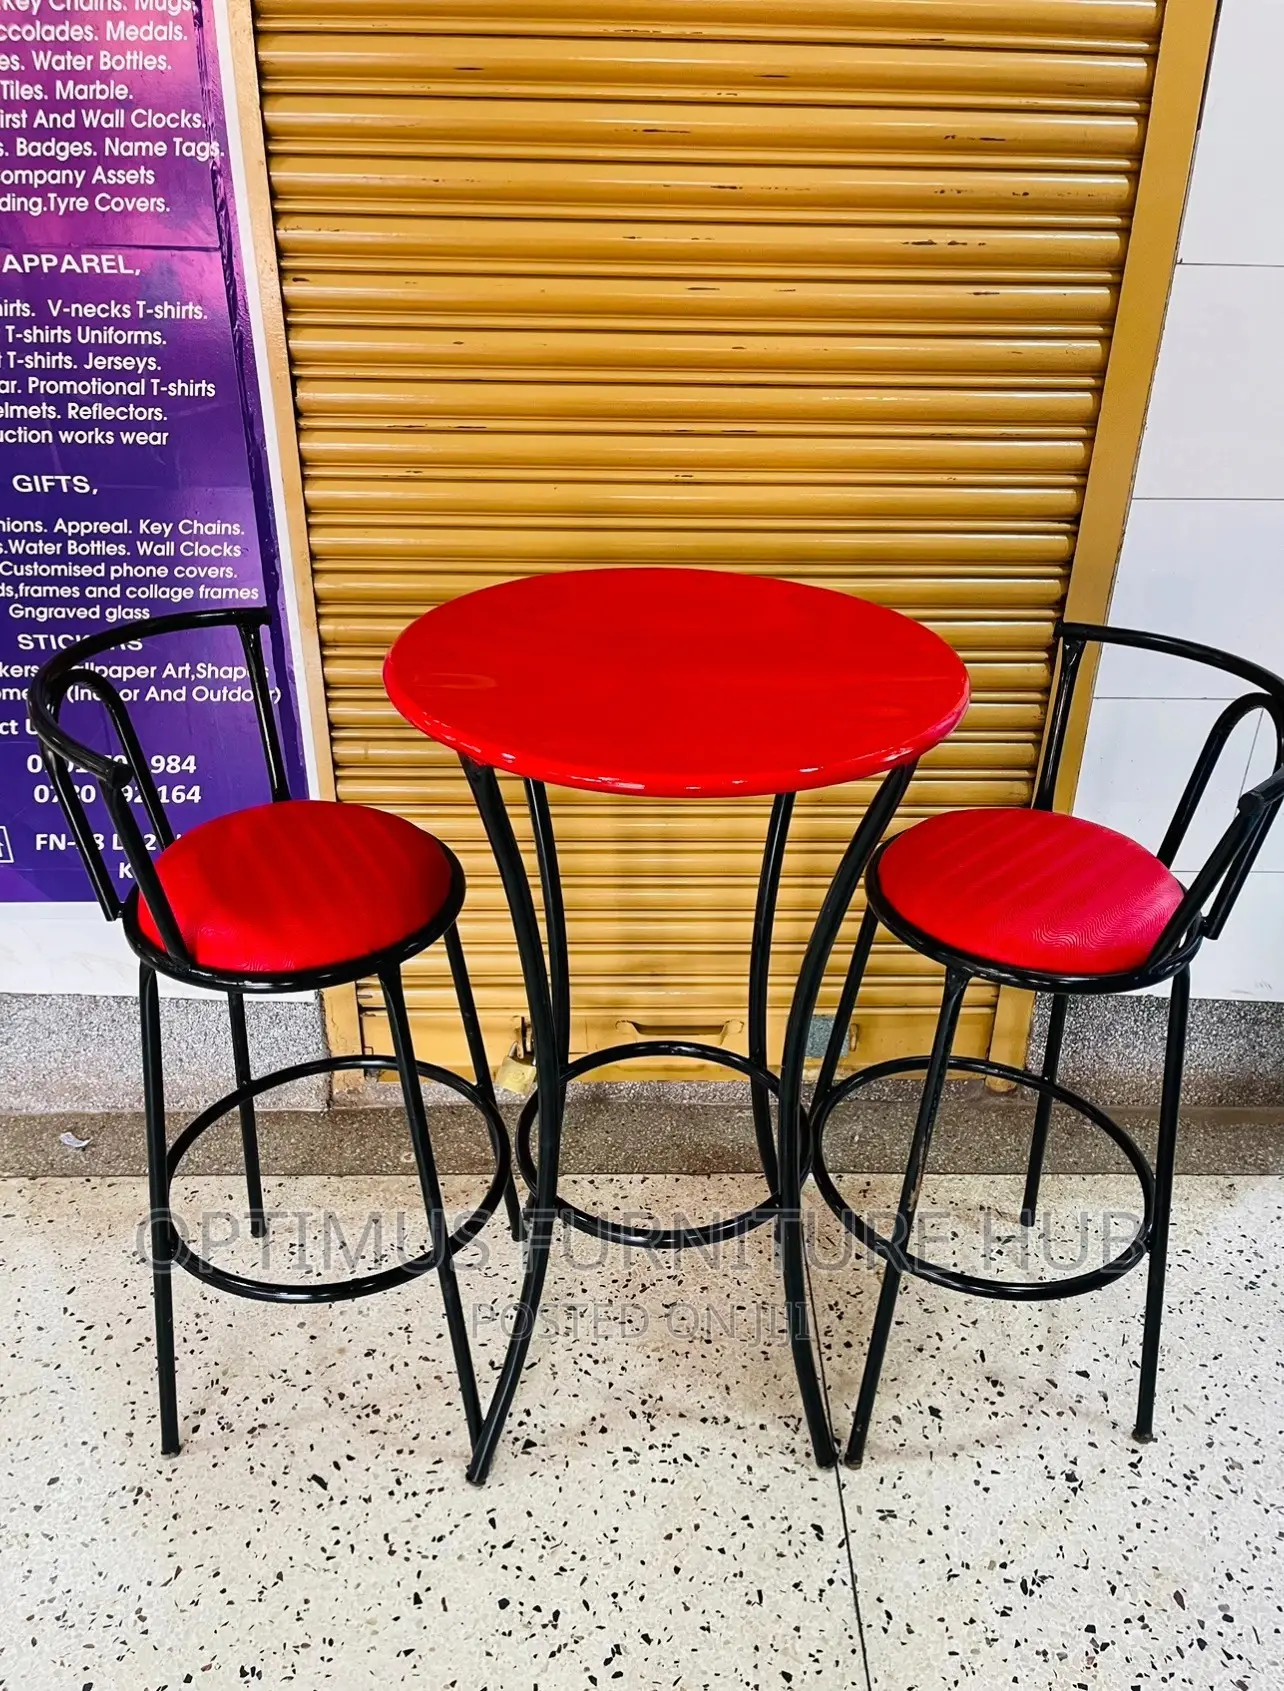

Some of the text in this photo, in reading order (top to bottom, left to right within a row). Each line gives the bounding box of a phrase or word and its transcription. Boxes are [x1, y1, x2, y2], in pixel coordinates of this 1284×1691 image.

[106, 20, 188, 42] Medals.
[31, 50, 94, 71] Water
[99, 50, 172, 71] Bottles.
[0, 79, 134, 101] Tiles. Marble.
[33, 109, 76, 129] And
[81, 108, 125, 129] Wall
[130, 108, 206, 129] Clocks.
[16, 137, 97, 162] Badges.
[104, 137, 168, 157] Name
[172, 137, 225, 162] Tags.
[91, 165, 155, 185] Assets
[94, 192, 171, 213] Covers.
[2, 254, 141, 276] APPAREL,
[0, 299, 208, 320] irts. V-necks T-shirts.
[5, 325, 167, 345] T-shirts Uniforms.
[6, 351, 78, 370] T-shirts.
[83, 352, 162, 374] Jerseys.
[28, 376, 146, 396] Promotional
[150, 378, 216, 398] T-shirts
[67, 402, 168, 421] Reflectors.
[58, 427, 115, 445] works
[119, 431, 169, 446] wear
[12, 474, 98, 495] GIFTS,
[53, 517, 133, 537] Appreal.
[139, 519, 174, 538] Key
[178, 519, 245, 536] Chains.
[67, 539, 131, 556] Bottles.
[136, 540, 175, 557] Wall
[179, 541, 242, 558] Clocks
[0, 560, 238, 581] Customised phone covers.
[84, 583, 121, 599] and
[125, 583, 195, 603] collage
[198, 584, 259, 600] frames
[8, 603, 150, 623] Gngraved glass
[144, 685, 187, 702] And
[191, 685, 282, 704] Outdor)
[150, 754, 197, 774] 984
[157, 784, 202, 804] 164
